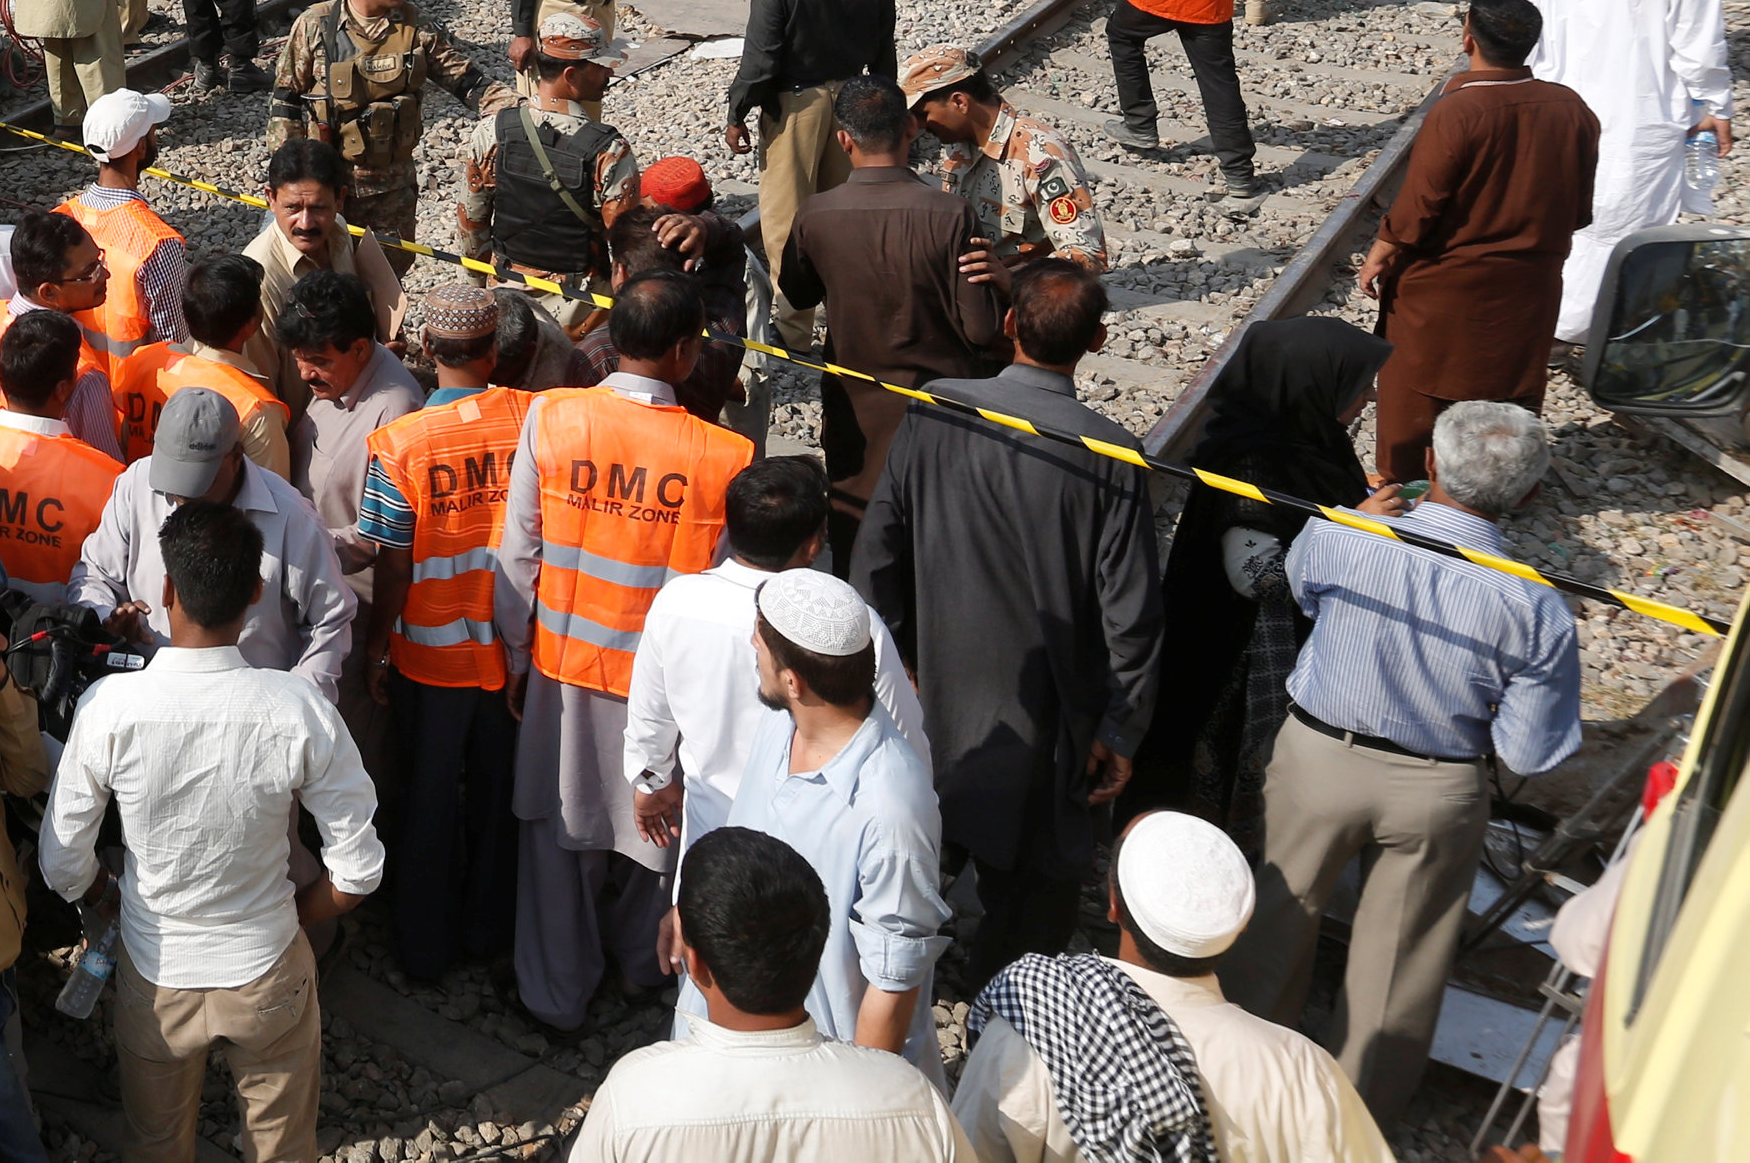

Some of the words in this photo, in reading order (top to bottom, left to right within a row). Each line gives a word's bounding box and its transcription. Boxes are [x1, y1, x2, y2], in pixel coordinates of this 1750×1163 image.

[570, 459, 689, 509] DMC
[430, 491, 484, 517] MALIR
[566, 493, 624, 517] MALIR
[628, 505, 682, 526] ZONE
[16, 527, 63, 549] ZONE
